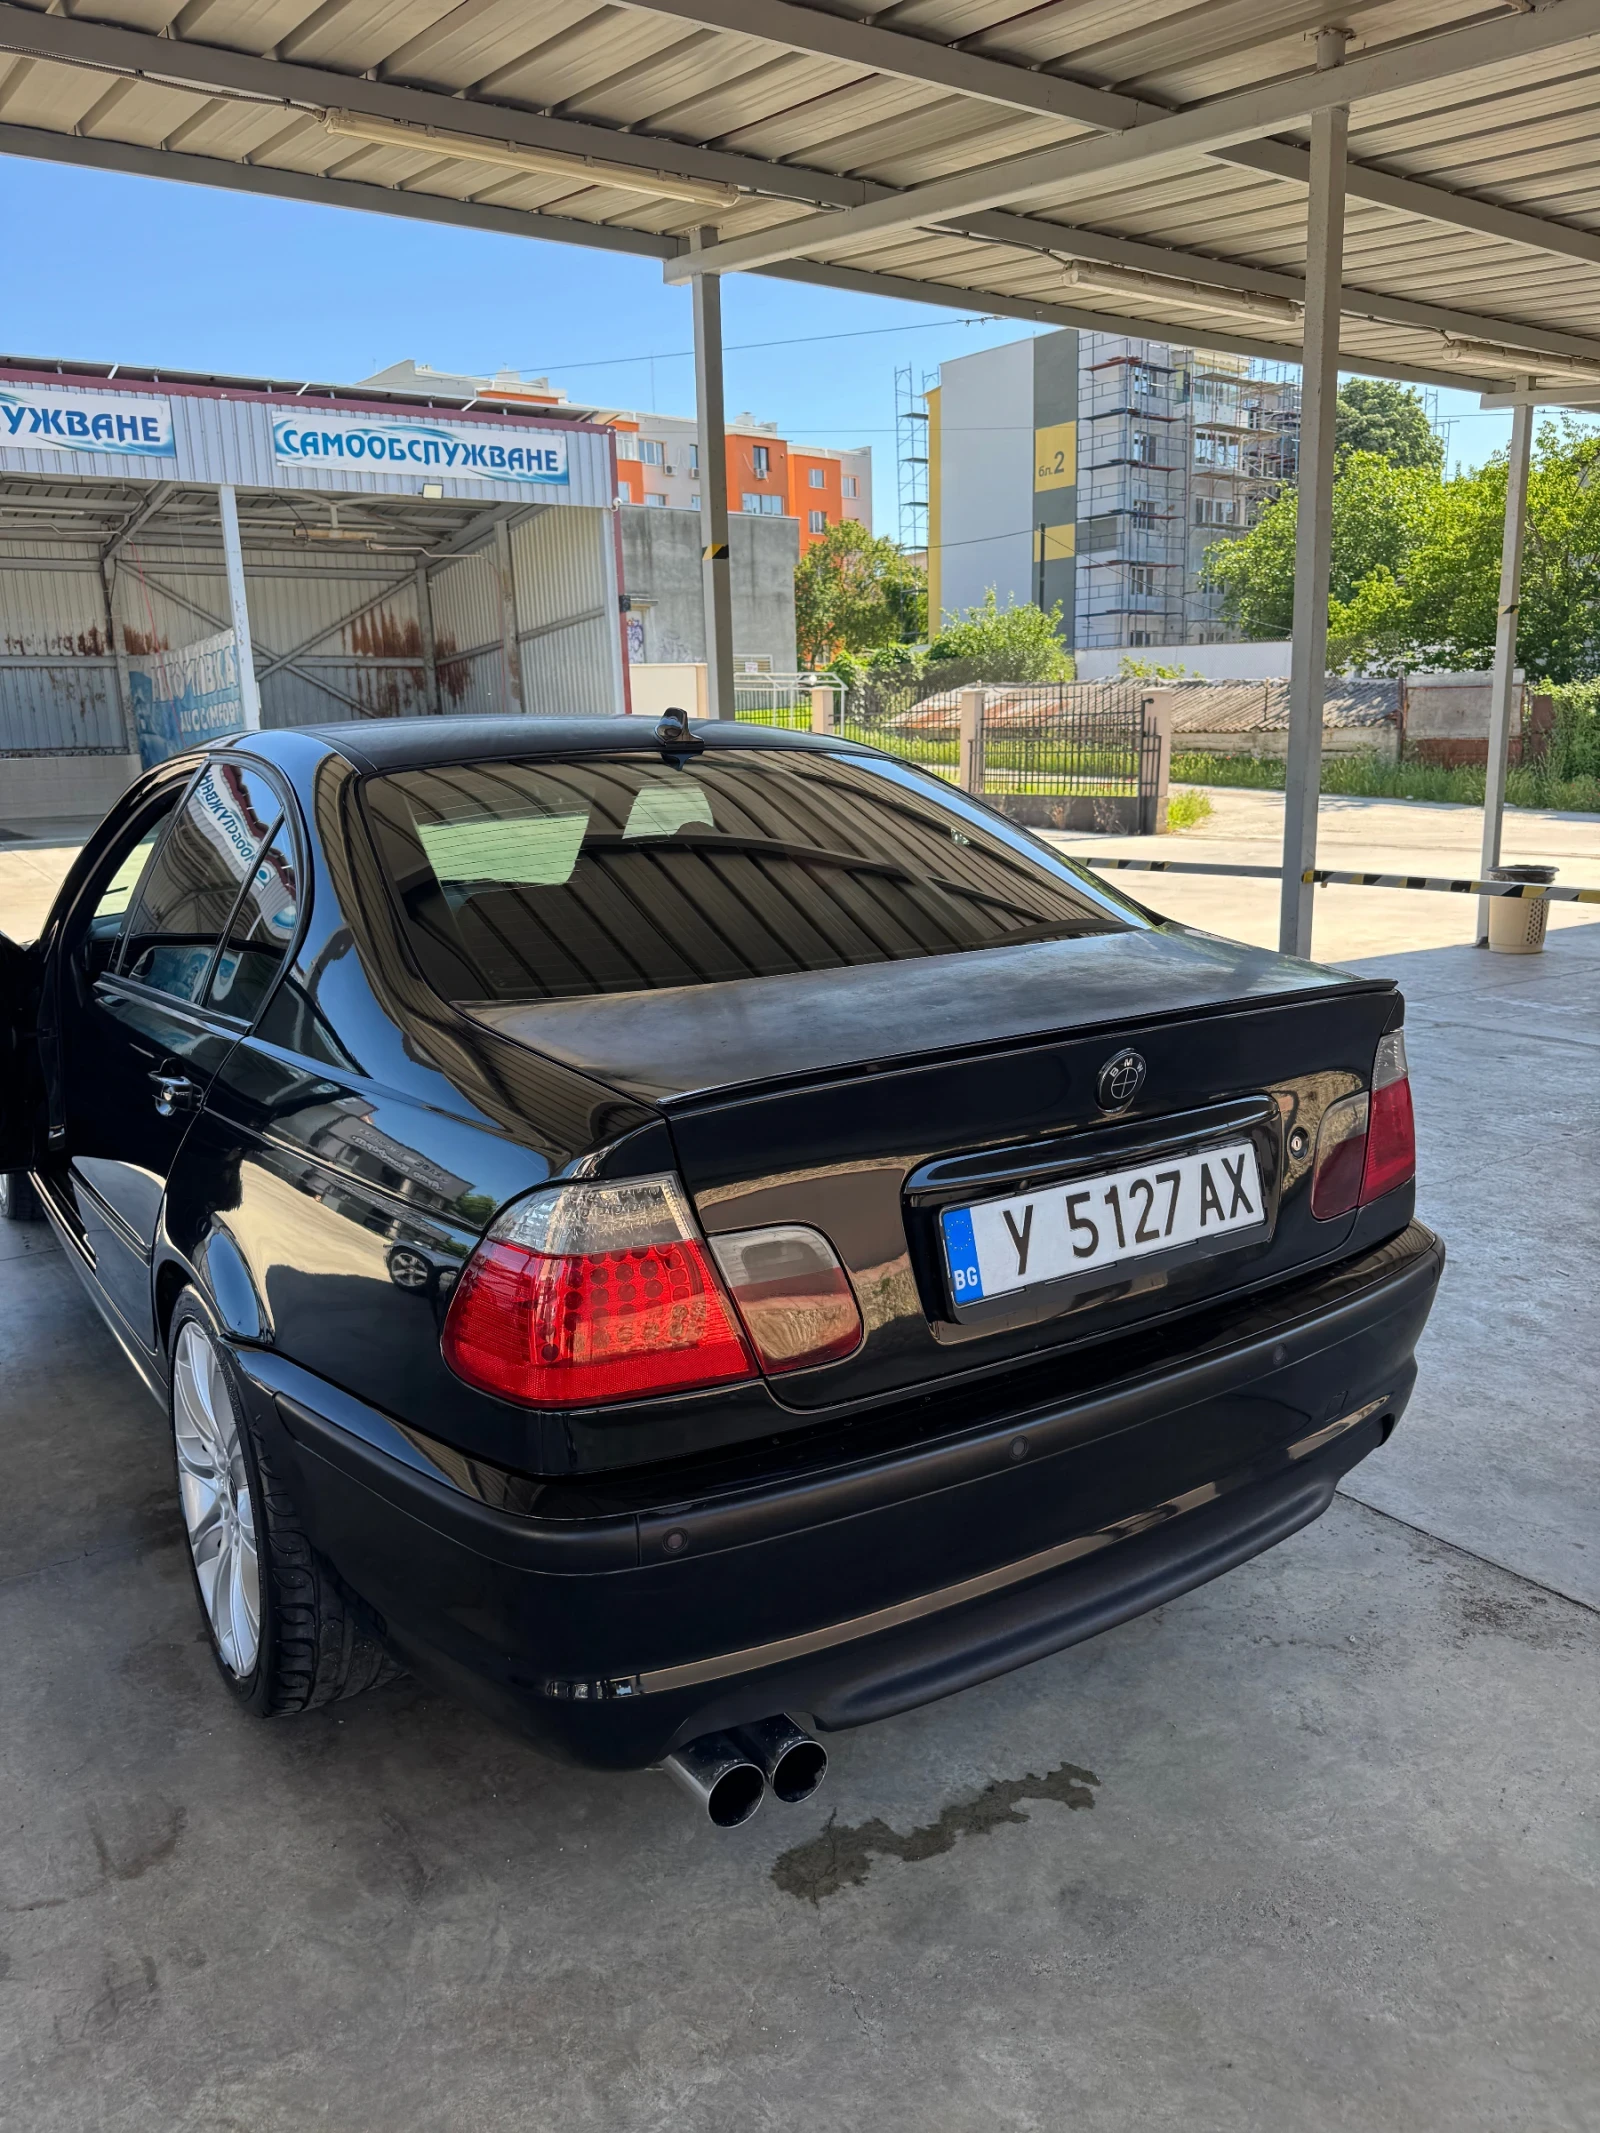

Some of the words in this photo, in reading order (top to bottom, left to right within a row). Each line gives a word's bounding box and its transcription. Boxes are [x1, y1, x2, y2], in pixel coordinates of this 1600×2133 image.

[1, 405, 161, 442] УЖВАНЕ
[283, 429, 559, 472] САМООБСЛУЖВАНЕ
[1109, 1058, 1144, 1077] BMW
[1065, 1170, 1181, 1258] 5127
[1200, 1153, 1254, 1227] AX
[954, 1266, 978, 1290] BG
